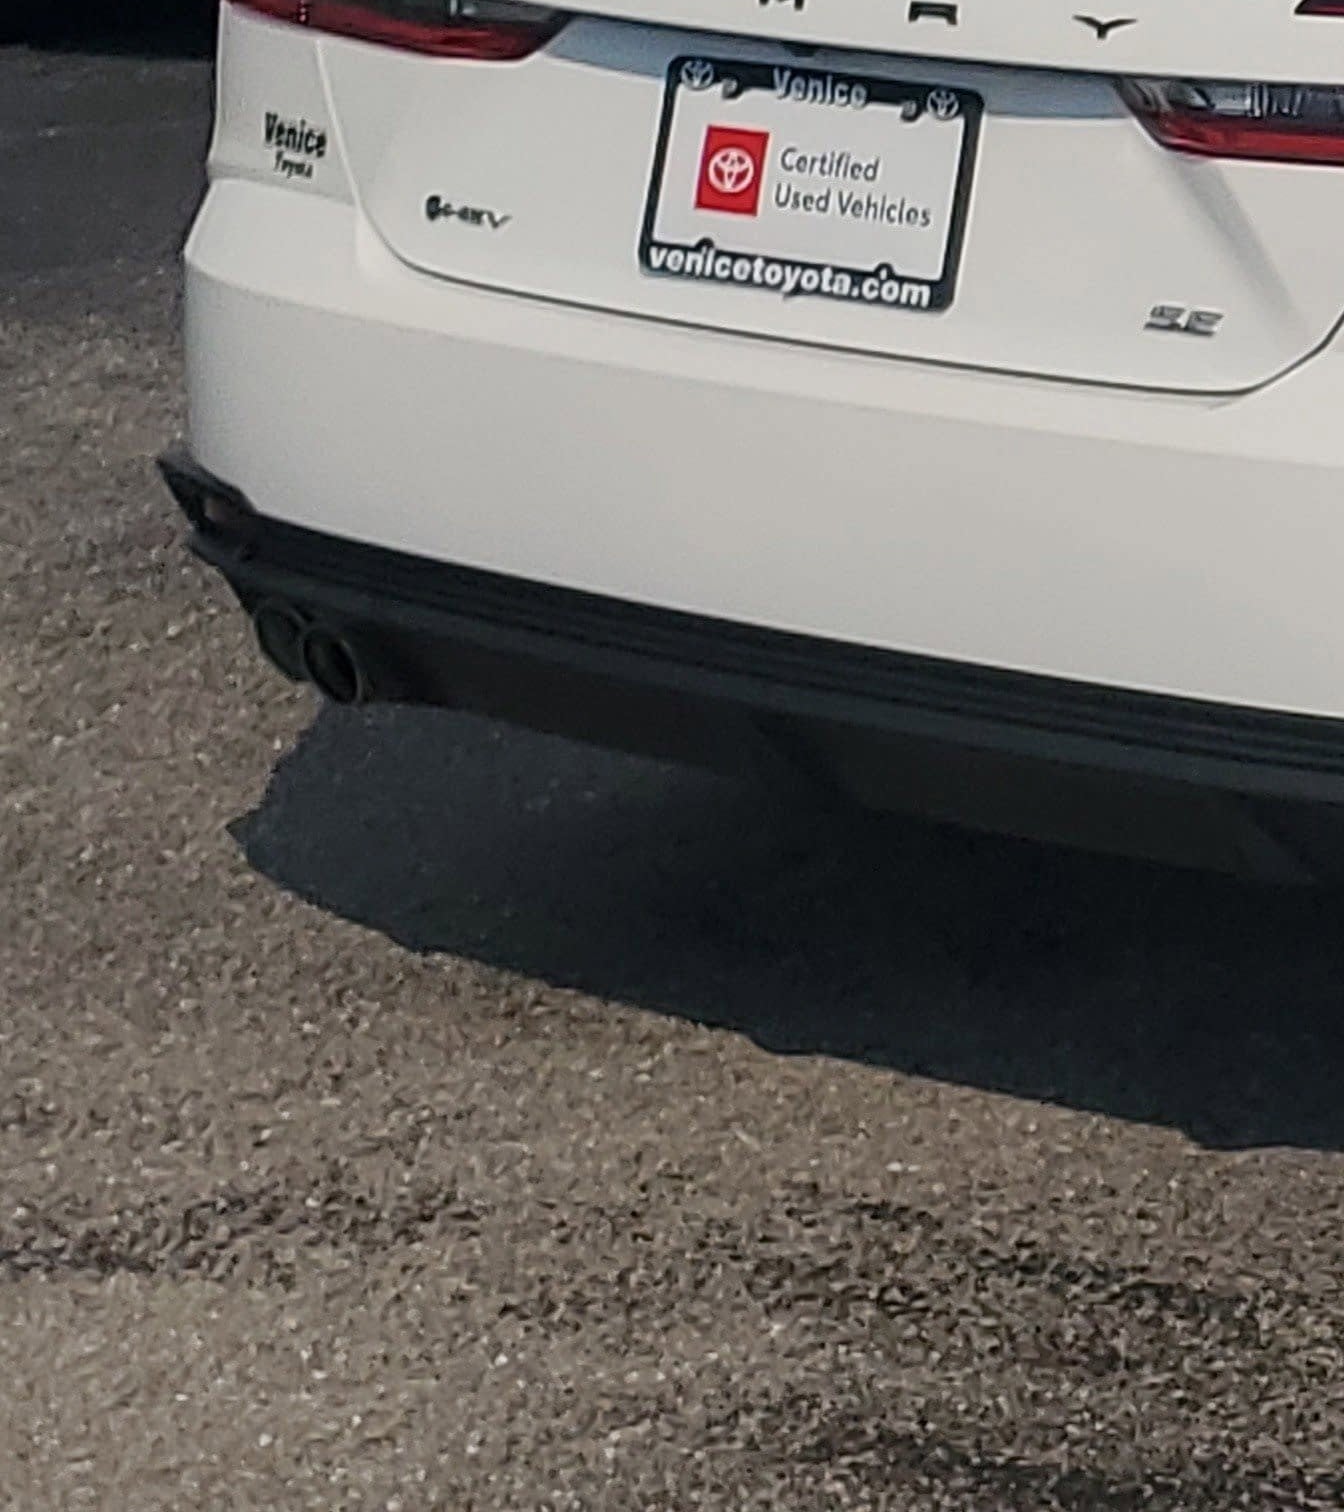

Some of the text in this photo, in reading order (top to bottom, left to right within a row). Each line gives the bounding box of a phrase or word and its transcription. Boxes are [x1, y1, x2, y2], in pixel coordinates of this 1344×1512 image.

[773, 69, 868, 108] Venice
[264, 111, 327, 158] Venice
[780, 147, 880, 182] Certified
[774, 182, 932, 228] Used Vehicles
[649, 245, 932, 309] venicetoyota.com
[1143, 304, 1224, 337] SE
